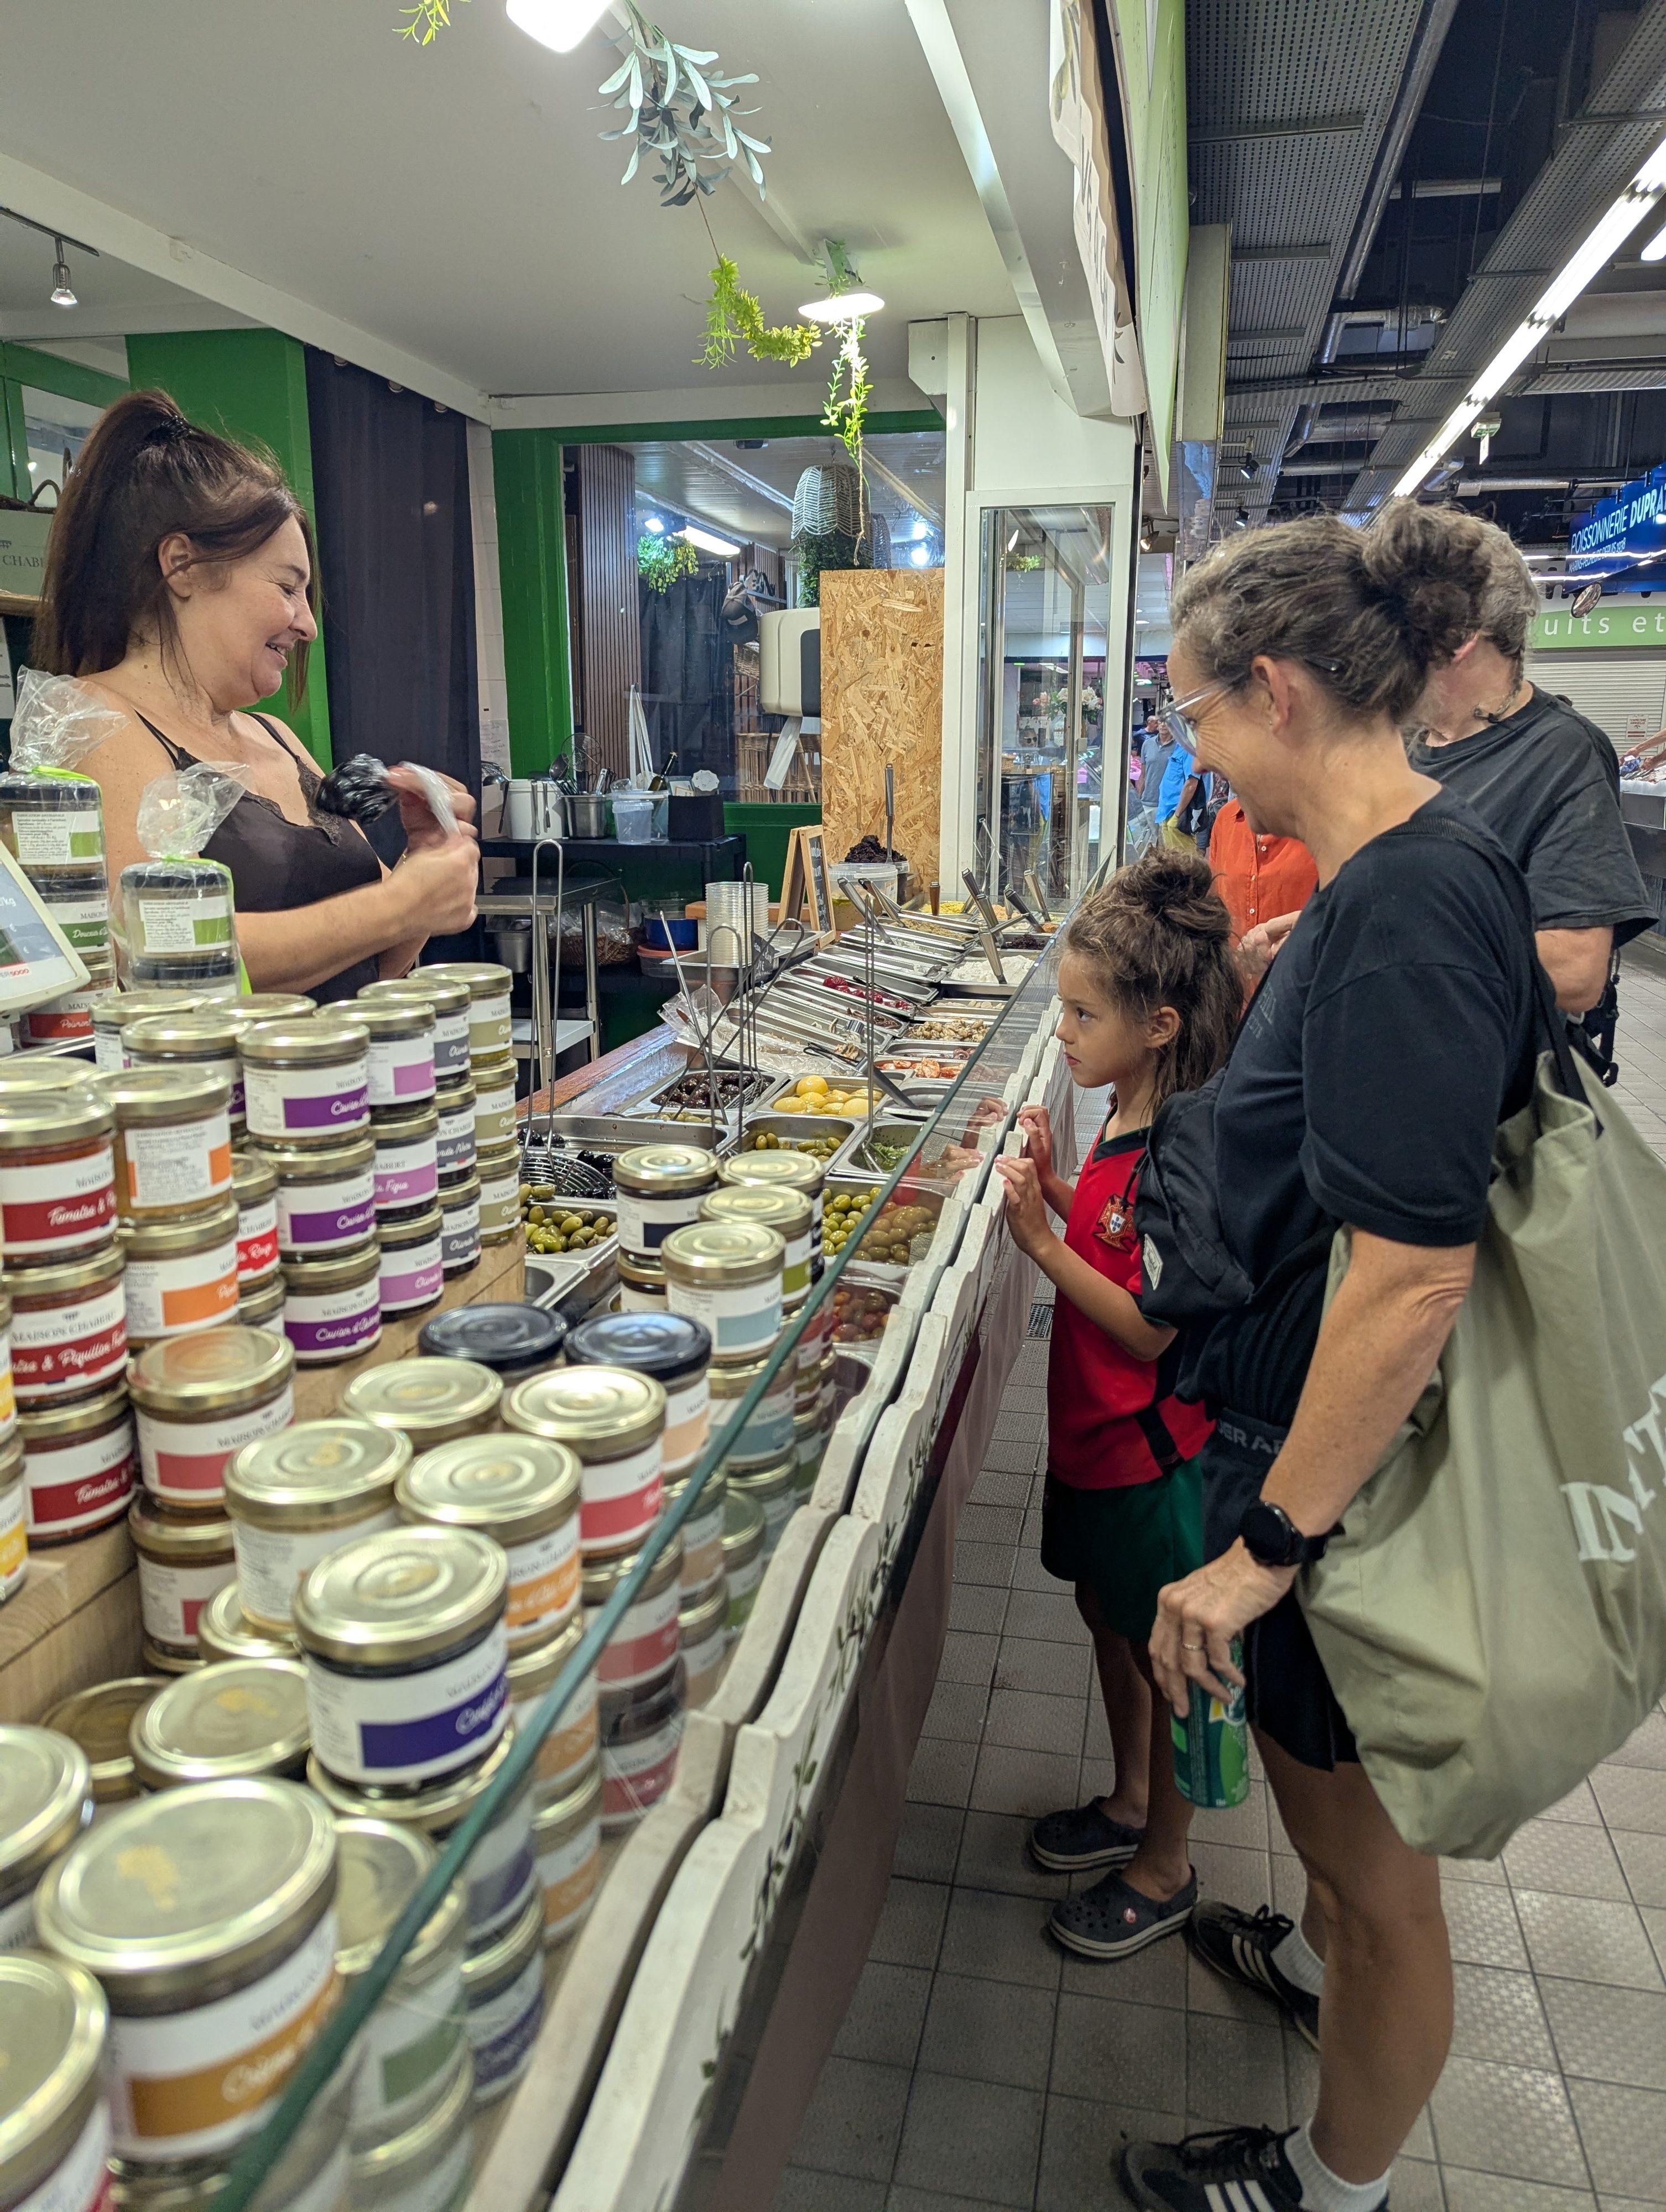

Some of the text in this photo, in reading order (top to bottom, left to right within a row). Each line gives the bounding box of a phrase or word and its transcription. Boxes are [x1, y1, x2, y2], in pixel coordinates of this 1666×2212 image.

[1571, 504, 1629, 555] POISSONNERIE
[1544, 613, 1665, 635] uits et
[48, 1206, 97, 1227] Tomates
[315, 1327, 352, 1342] Caviar
